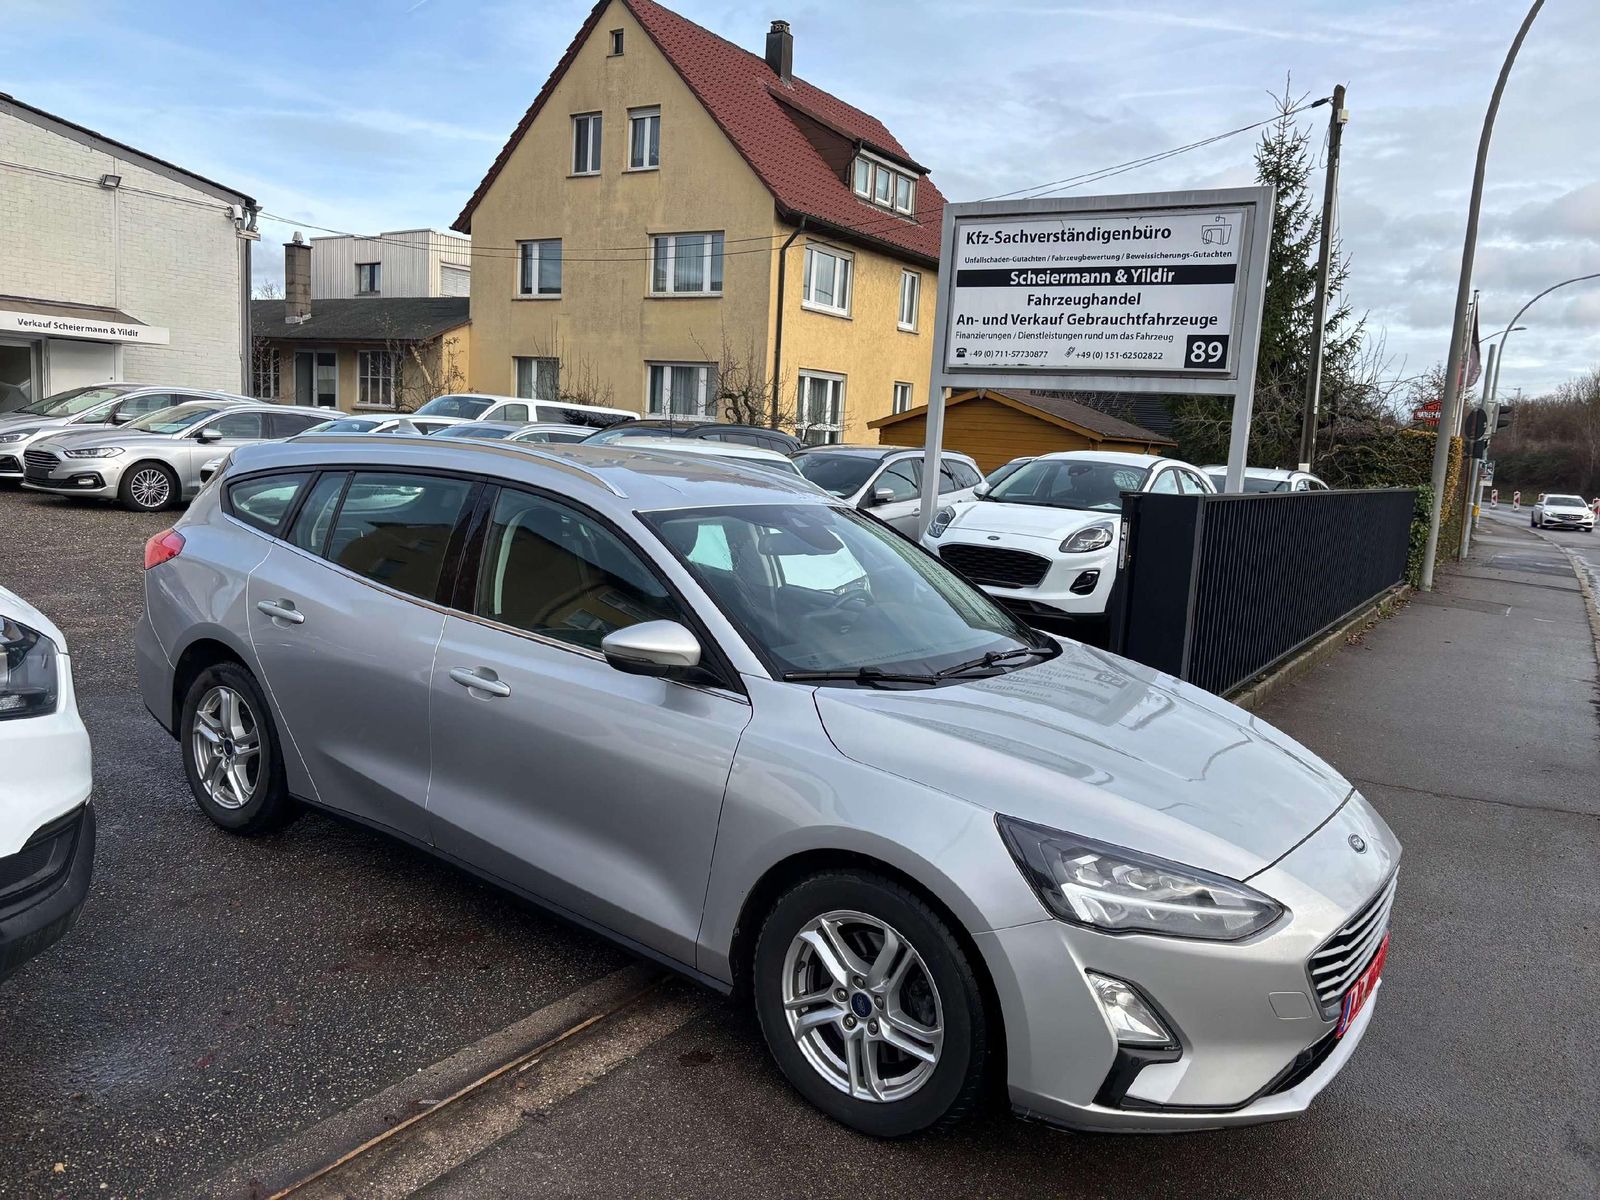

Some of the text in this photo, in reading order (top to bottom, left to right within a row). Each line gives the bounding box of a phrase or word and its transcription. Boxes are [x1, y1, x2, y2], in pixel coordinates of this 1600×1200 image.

[966, 225, 1172, 245] Kfz-Sachverständigenbüro
[964, 255, 1046, 264] Unfallschaden-Gutachten
[1051, 253, 1120, 262] Fahrzeugbewertung
[1126, 250, 1232, 260] Beweissicherungs-Gutachten
[1010, 267, 1175, 285] Scheiermann & Yildir
[1027, 292, 1141, 309] Fahrzeughandel
[17, 318, 139, 337] Verkauf Scheiermann & Yildir
[956, 312, 1218, 329] An- und Verkauf Gebrauchtfahrzeuge
[955, 331, 1012, 340] Finanzierungen
[1017, 331, 1083, 341] Dienstleistungen
[1084, 331, 1104, 340] rund
[1119, 332, 1134, 340] das
[1135, 332, 1174, 343] Fahrzeug
[983, 350, 994, 359] (0)
[994, 350, 1049, 358] 711-57730877
[1075, 351, 1164, 360] +49 (0) 151-62502822
[1190, 341, 1224, 363] 89
